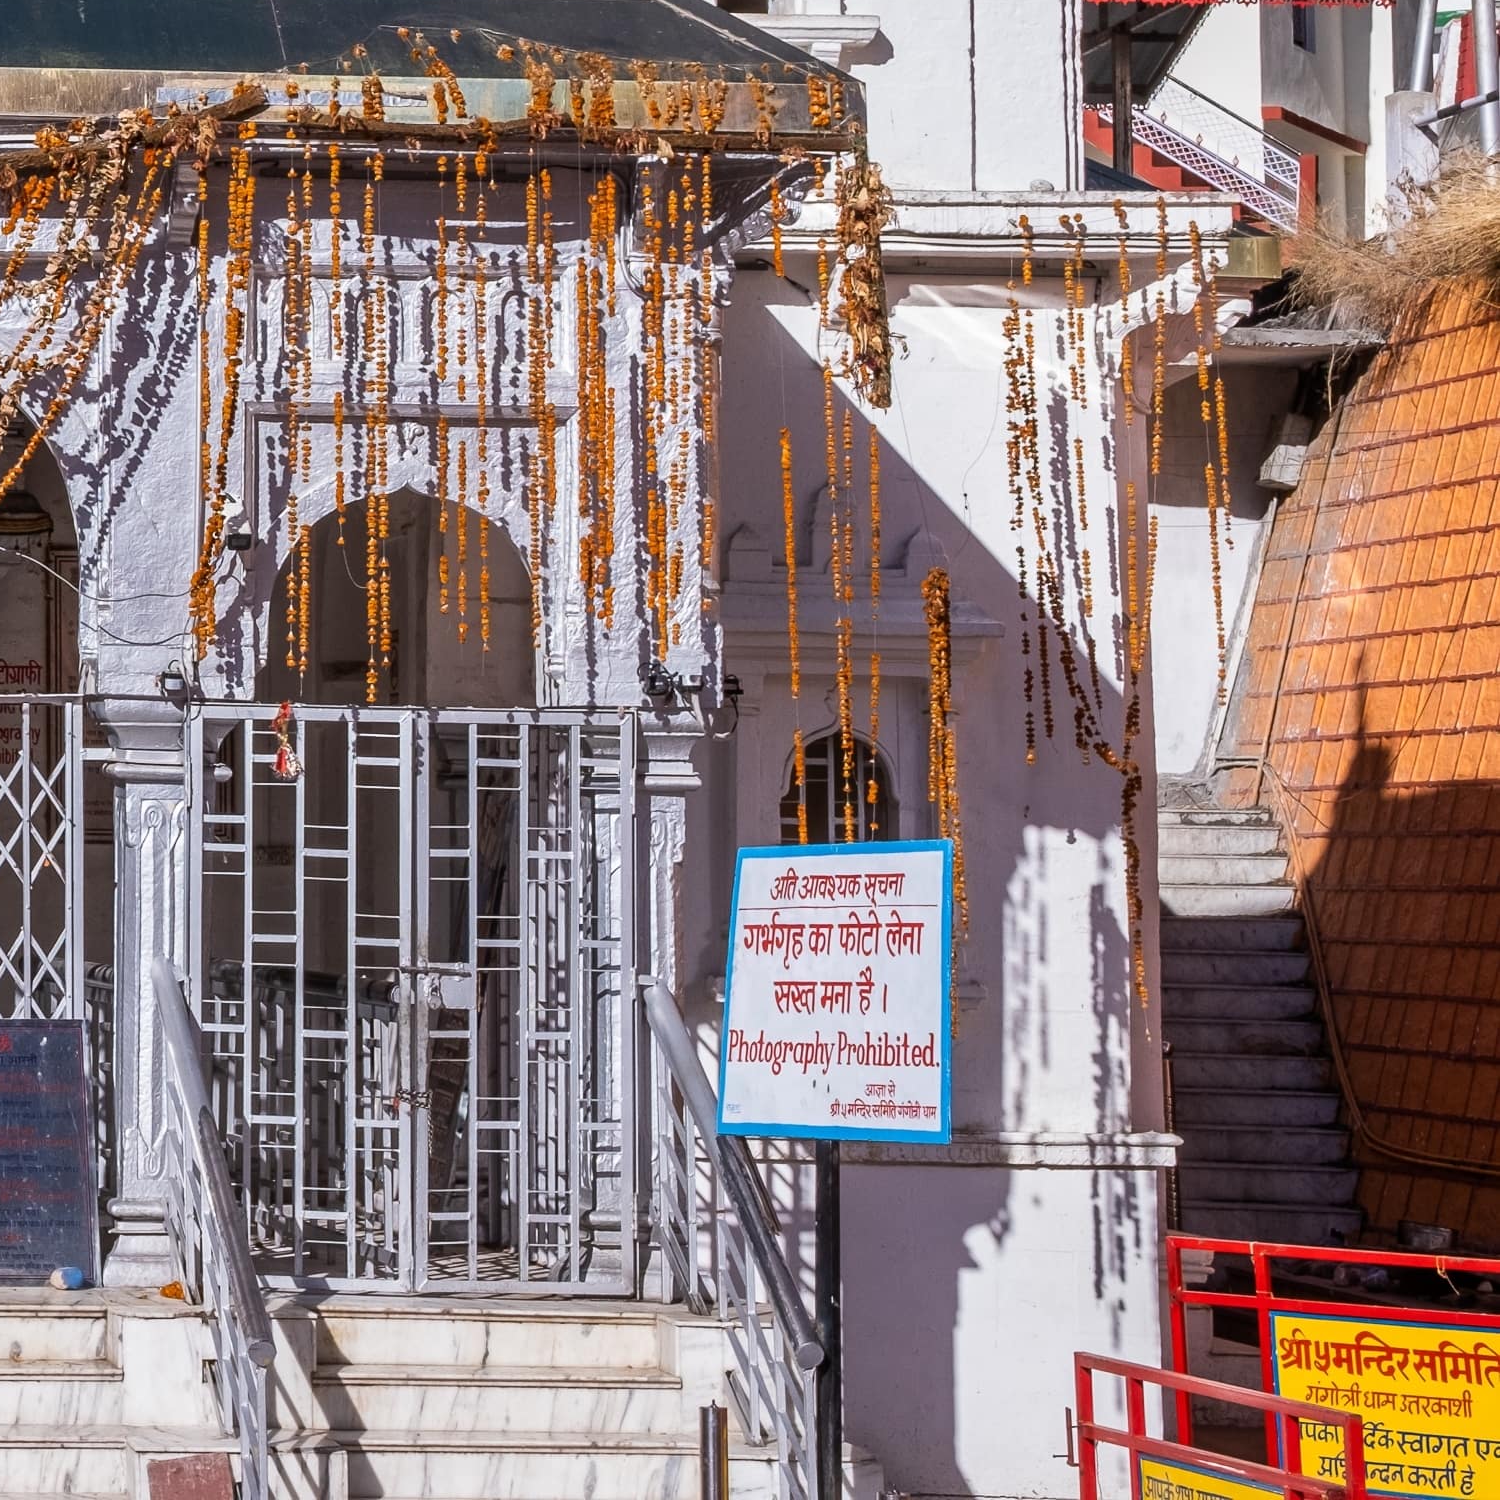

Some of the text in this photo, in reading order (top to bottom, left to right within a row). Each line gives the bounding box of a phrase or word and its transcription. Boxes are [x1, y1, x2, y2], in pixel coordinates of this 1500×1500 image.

[770, 867, 905, 907] अति आवश्यक सूचना
[743, 909, 924, 969] गर्भगृह का फोटो लेना
[774, 980, 817, 1014] सख्त
[821, 981, 853, 1014] मना
[856, 966, 874, 1016] है
[728, 1029, 940, 1076] Photography Prohibited.
[865, 1080, 896, 1097] आज्ञा से
[847, 1098, 871, 1120] मन्दिर
[872, 1100, 896, 1119] समिति
[1280, 1328, 1312, 1370] श्री
[1330, 1330, 1410, 1381] मन्दिर
[1306, 1380, 1362, 1408] गंगोत्री
[1364, 1390, 1398, 1411] धाम
[1397, 1430, 1470, 1458] स्वागत
[1408, 1459, 1456, 1491] करती
